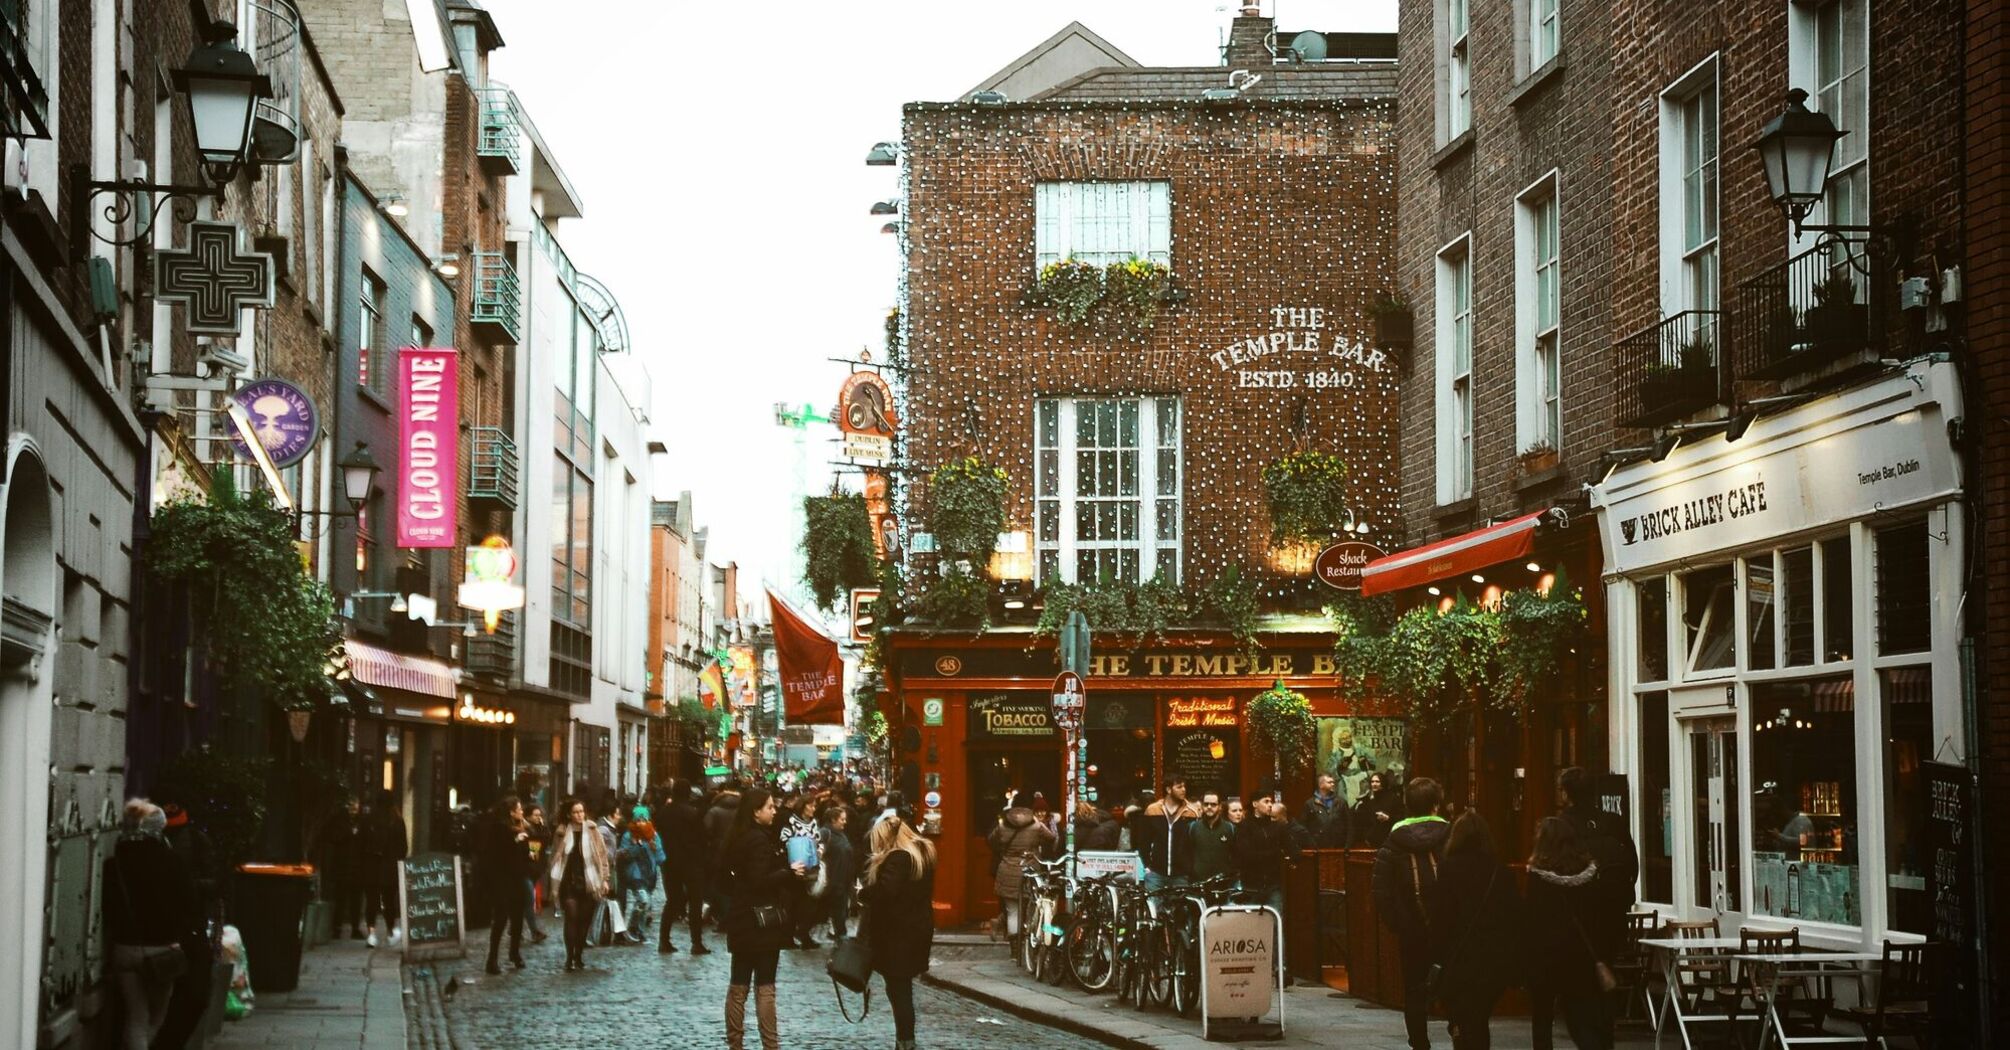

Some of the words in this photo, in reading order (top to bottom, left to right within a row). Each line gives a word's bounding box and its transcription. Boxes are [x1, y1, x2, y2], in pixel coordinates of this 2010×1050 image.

[1270, 307, 1325, 328] THE
[1210, 331, 1319, 371] TEMPLE
[1332, 336, 1387, 372] BAR
[1305, 371, 1353, 388] 1840
[411, 356, 446, 422] NINE
[238, 384, 276, 407] EAL'S
[281, 387, 310, 421] YARD
[854, 434, 880, 444] DUBLIN
[848, 447, 864, 457] LIVE
[409, 430, 444, 520] CLOUD
[1858, 469, 1881, 485] Temple
[1882, 466, 1897, 479] Bar,
[1897, 459, 1920, 475] Dublin
[1641, 505, 1681, 541] BRICK
[1684, 494, 1723, 530] ALLEY
[1728, 473, 1768, 519] CAFÉ
[1327, 567, 1360, 577] Restau
[940, 659, 956, 670] 48
[1080, 656, 1129, 675] HE
[1145, 655, 1293, 675] TEMPLE
[801, 672, 822, 681] THE
[801, 689, 825, 701] BAR
[1169, 700, 1233, 714] Traditional
[981, 710, 1047, 732] TOBACCO
[1167, 714, 1197, 726] Irish
[1202, 713, 1236, 726] Music
[1179, 733, 1208, 747] TEMPLE
[1371, 737, 1403, 750] BAR
